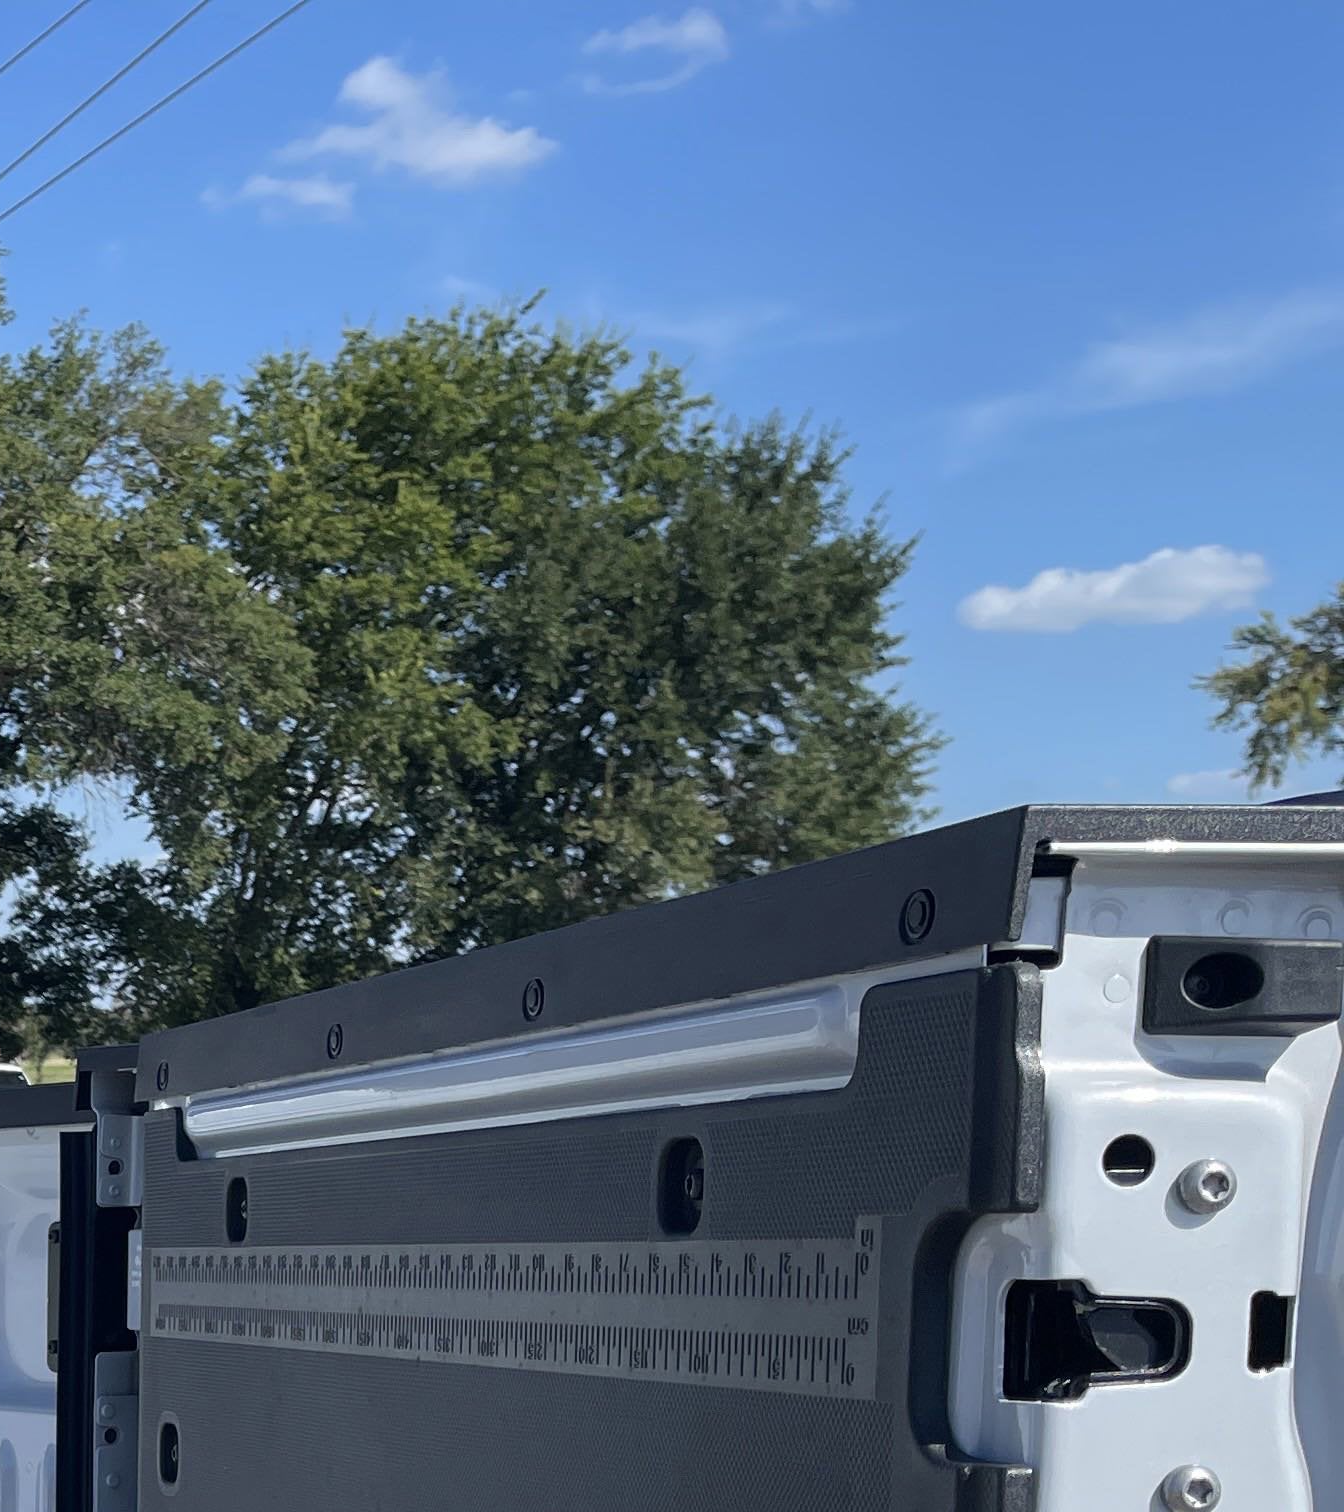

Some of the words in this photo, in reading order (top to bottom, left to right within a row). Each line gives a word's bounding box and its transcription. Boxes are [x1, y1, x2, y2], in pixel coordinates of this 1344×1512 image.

[860, 1229, 874, 1252] in
[623, 1253, 629, 1273] 7
[683, 1253, 690, 1274] 5
[715, 1253, 723, 1273] 4
[748, 1252, 757, 1275] 3
[783, 1252, 793, 1274] 2
[860, 1252, 869, 1275] 0
[847, 1317, 869, 1335] cm
[772, 1359, 781, 1380] 5
[845, 1362, 855, 1386] 0
